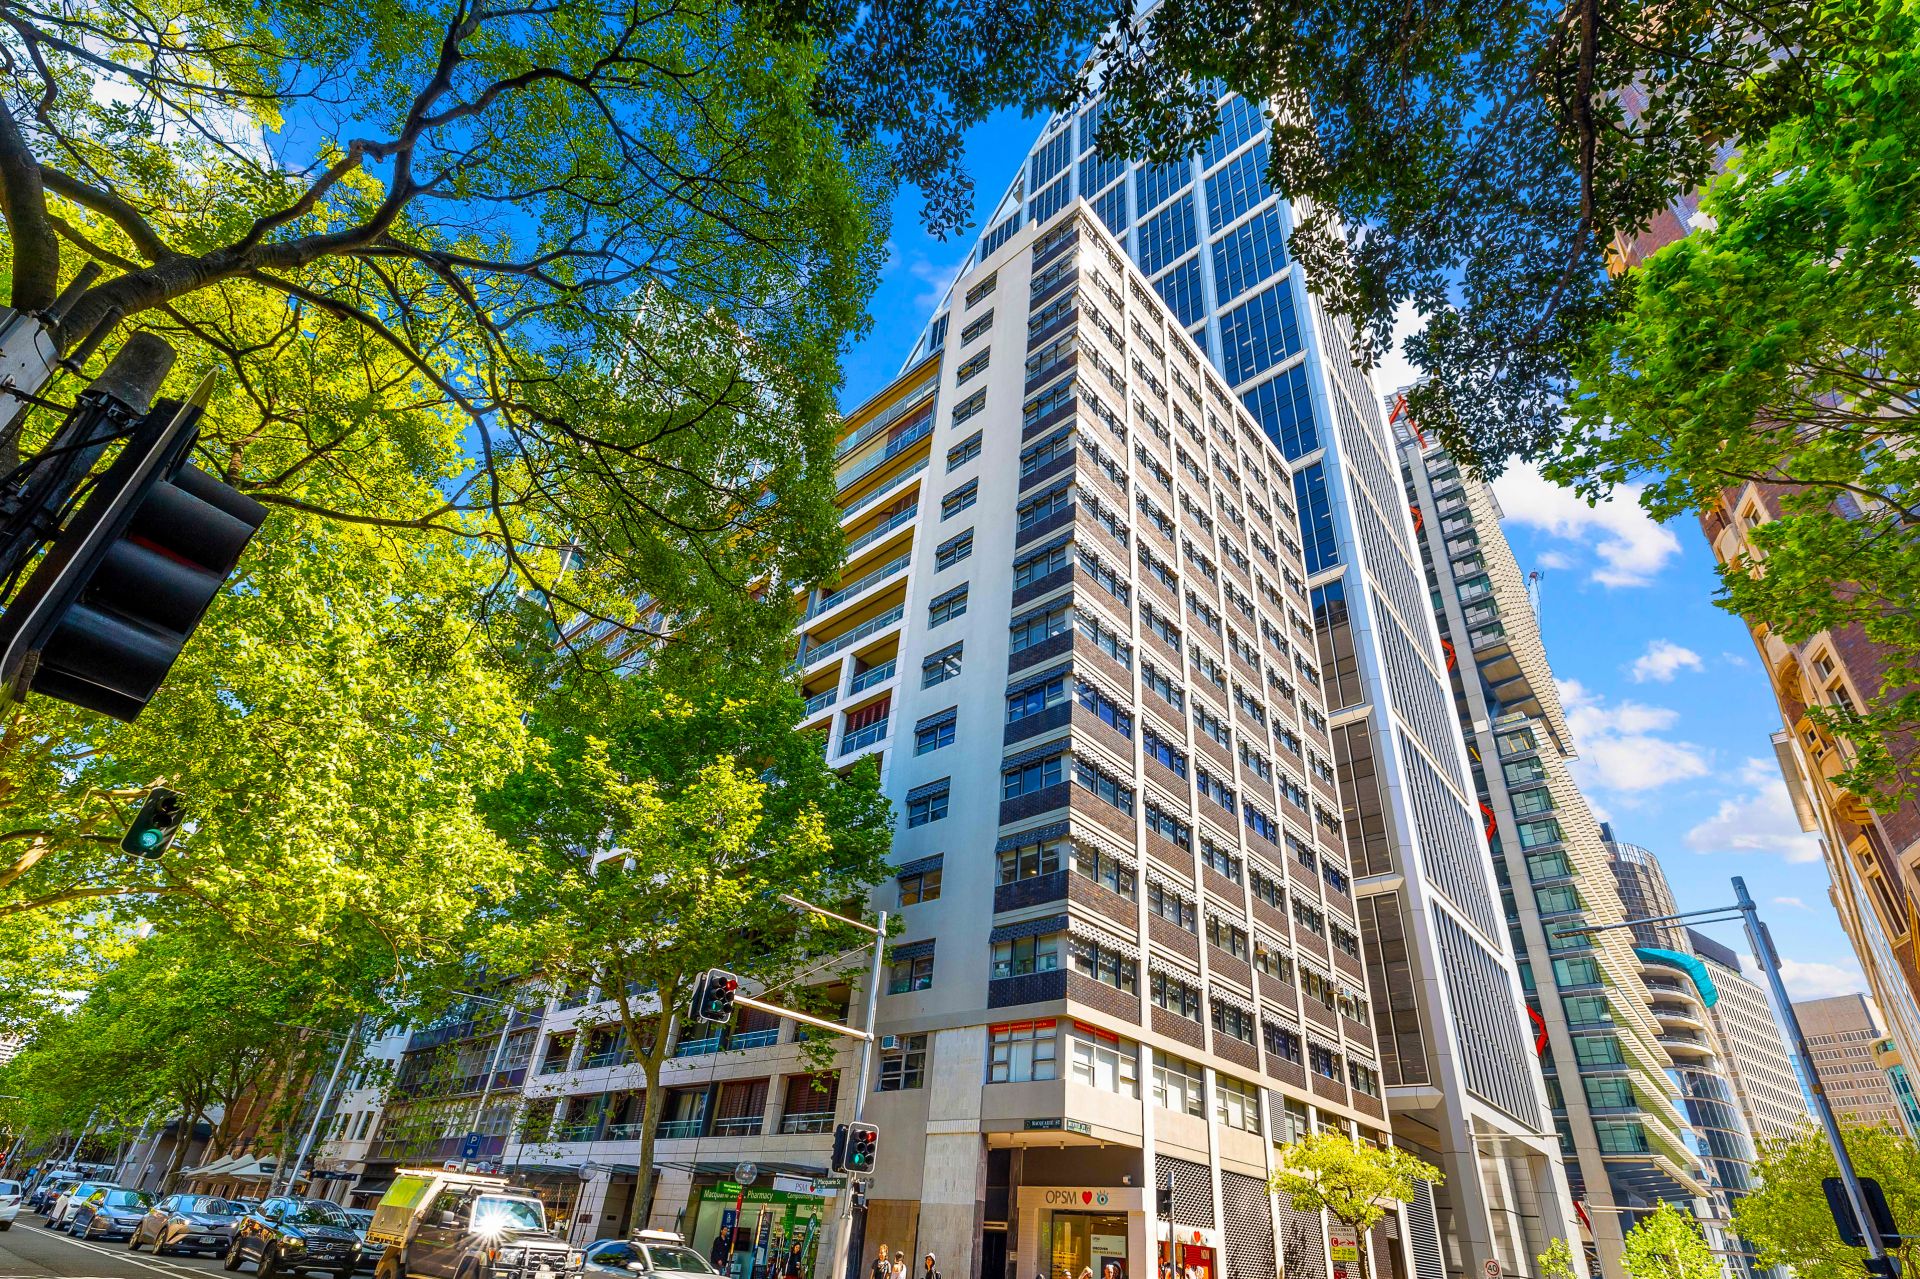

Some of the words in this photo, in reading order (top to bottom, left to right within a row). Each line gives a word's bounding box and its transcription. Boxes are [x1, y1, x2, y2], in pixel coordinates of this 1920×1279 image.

[470, 1136, 478, 1144] P
[817, 1178, 837, 1186] Macquarie
[747, 1190, 774, 1202] Pharmacy
[1045, 1190, 1077, 1205] OPSM
[1487, 1264, 1498, 1272] 40
